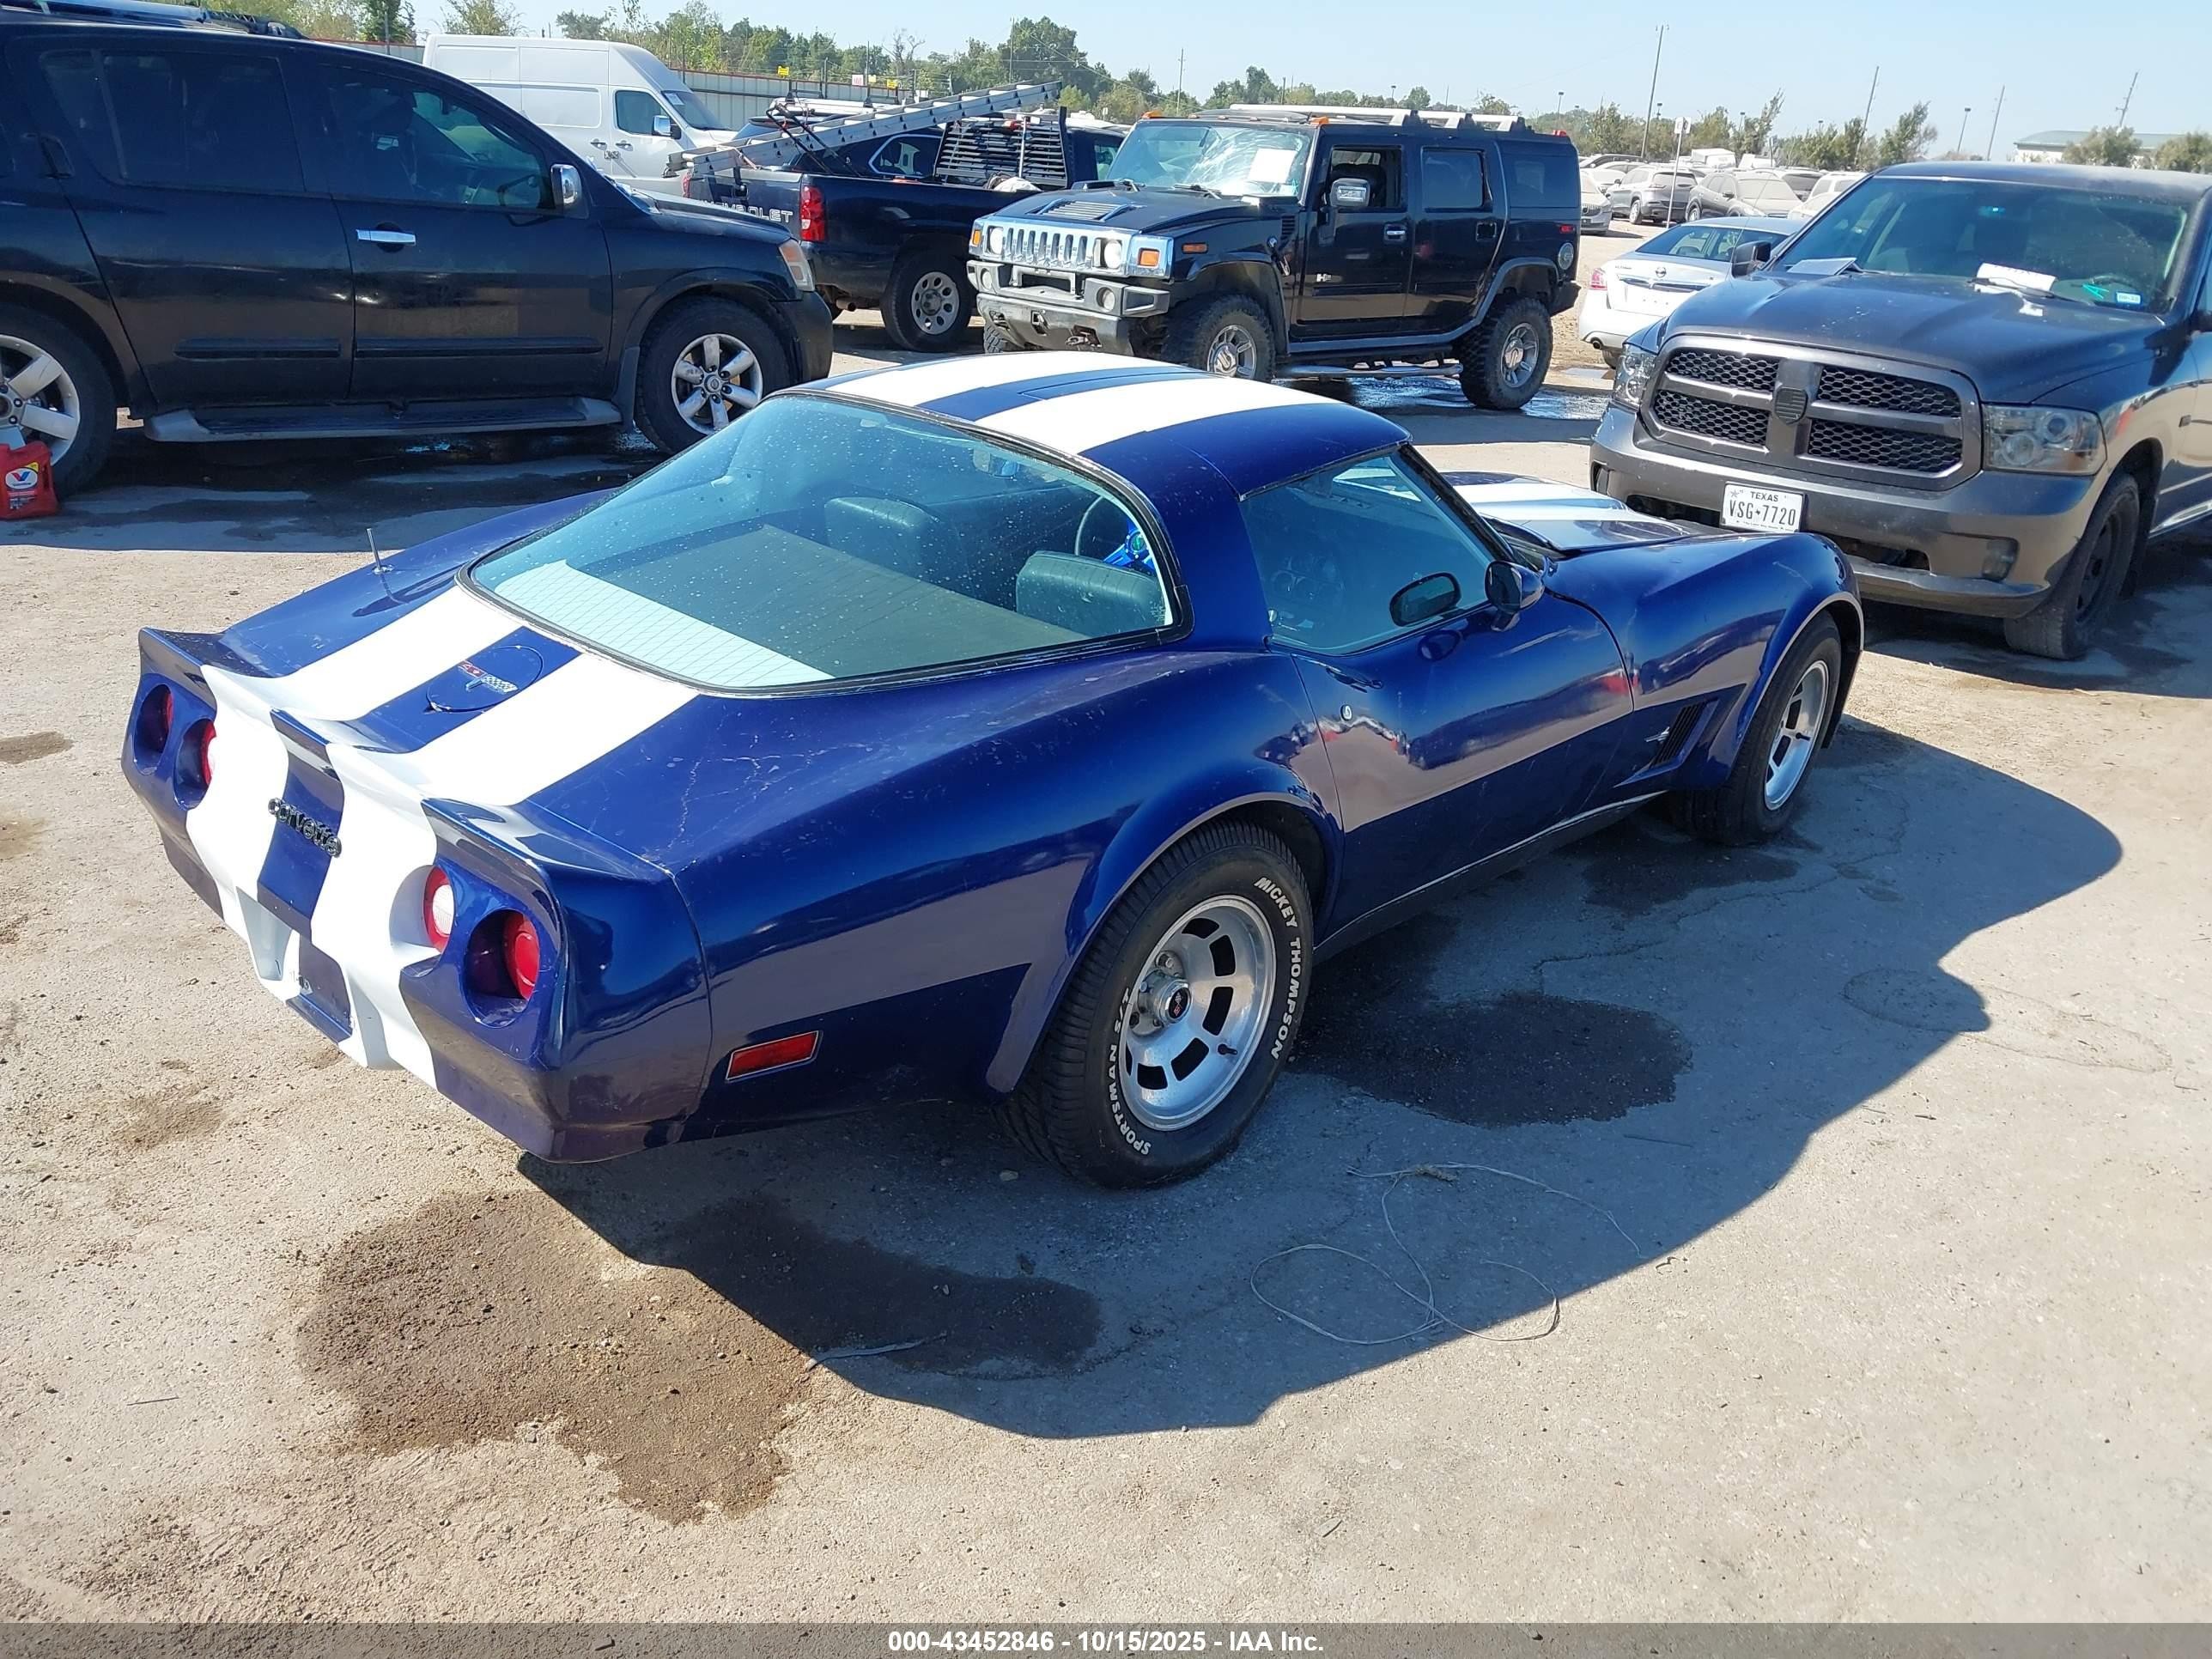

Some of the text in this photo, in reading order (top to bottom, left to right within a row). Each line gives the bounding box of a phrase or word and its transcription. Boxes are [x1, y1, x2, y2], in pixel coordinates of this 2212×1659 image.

[1750, 491, 1778, 501] TEXAS
[1254, 877, 1302, 1060] MICKEY THOMPSON
[1109, 1044, 1152, 1155] SPORTSMAN
